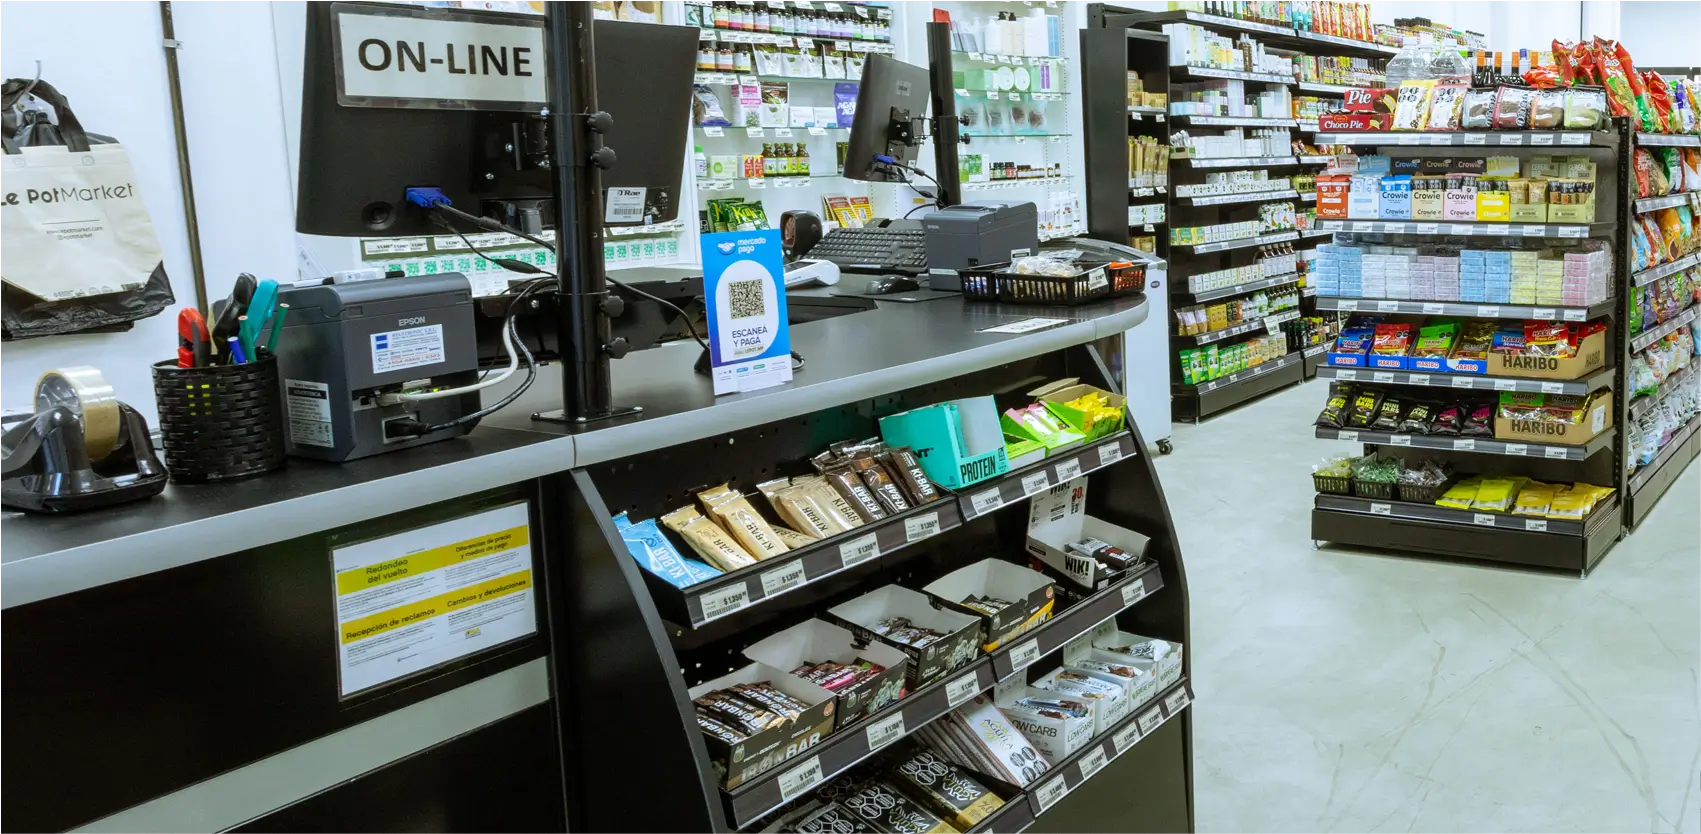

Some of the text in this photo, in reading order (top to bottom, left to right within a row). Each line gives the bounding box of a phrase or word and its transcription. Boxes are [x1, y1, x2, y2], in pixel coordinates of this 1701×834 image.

[358, 38, 532, 77] ON-LINE
[1347, 90, 1372, 105] Pie
[1324, 120, 1364, 128] Choco Pie
[27, 183, 133, 204] PotMarket
[1382, 192, 1408, 200] Crowie
[1414, 192, 1440, 200] Crowie
[1446, 192, 1474, 200] Crowie
[738, 237, 766, 246] mercado
[738, 246, 755, 254] pago
[398, 316, 426, 326] EPSON
[732, 325, 768, 338] ESCANEÁ
[733, 336, 761, 348] Y PAGA
[1502, 356, 1558, 370] HARIBO
[1356, 400, 1374, 409] BARS
[1512, 419, 1566, 435] HARIBO
[960, 455, 996, 484] PROTEIN
[854, 485, 880, 512] KI-BAR
[456, 541, 485, 552] Diferencias
[494, 534, 511, 545] precio
[466, 547, 484, 557] medios
[494, 542, 508, 552] pago
[366, 558, 408, 575] Redondeo
[654, 546, 685, 579] KI-BAR
[1065, 556, 1090, 576] WIK!
[367, 567, 408, 584] del vuelto
[447, 594, 477, 607] Cambios
[484, 580, 526, 596] devoluciones
[346, 622, 388, 640] Recepción
[389, 618, 399, 627] de
[402, 608, 436, 622] reclamos
[984, 719, 1014, 750] AGUILA
